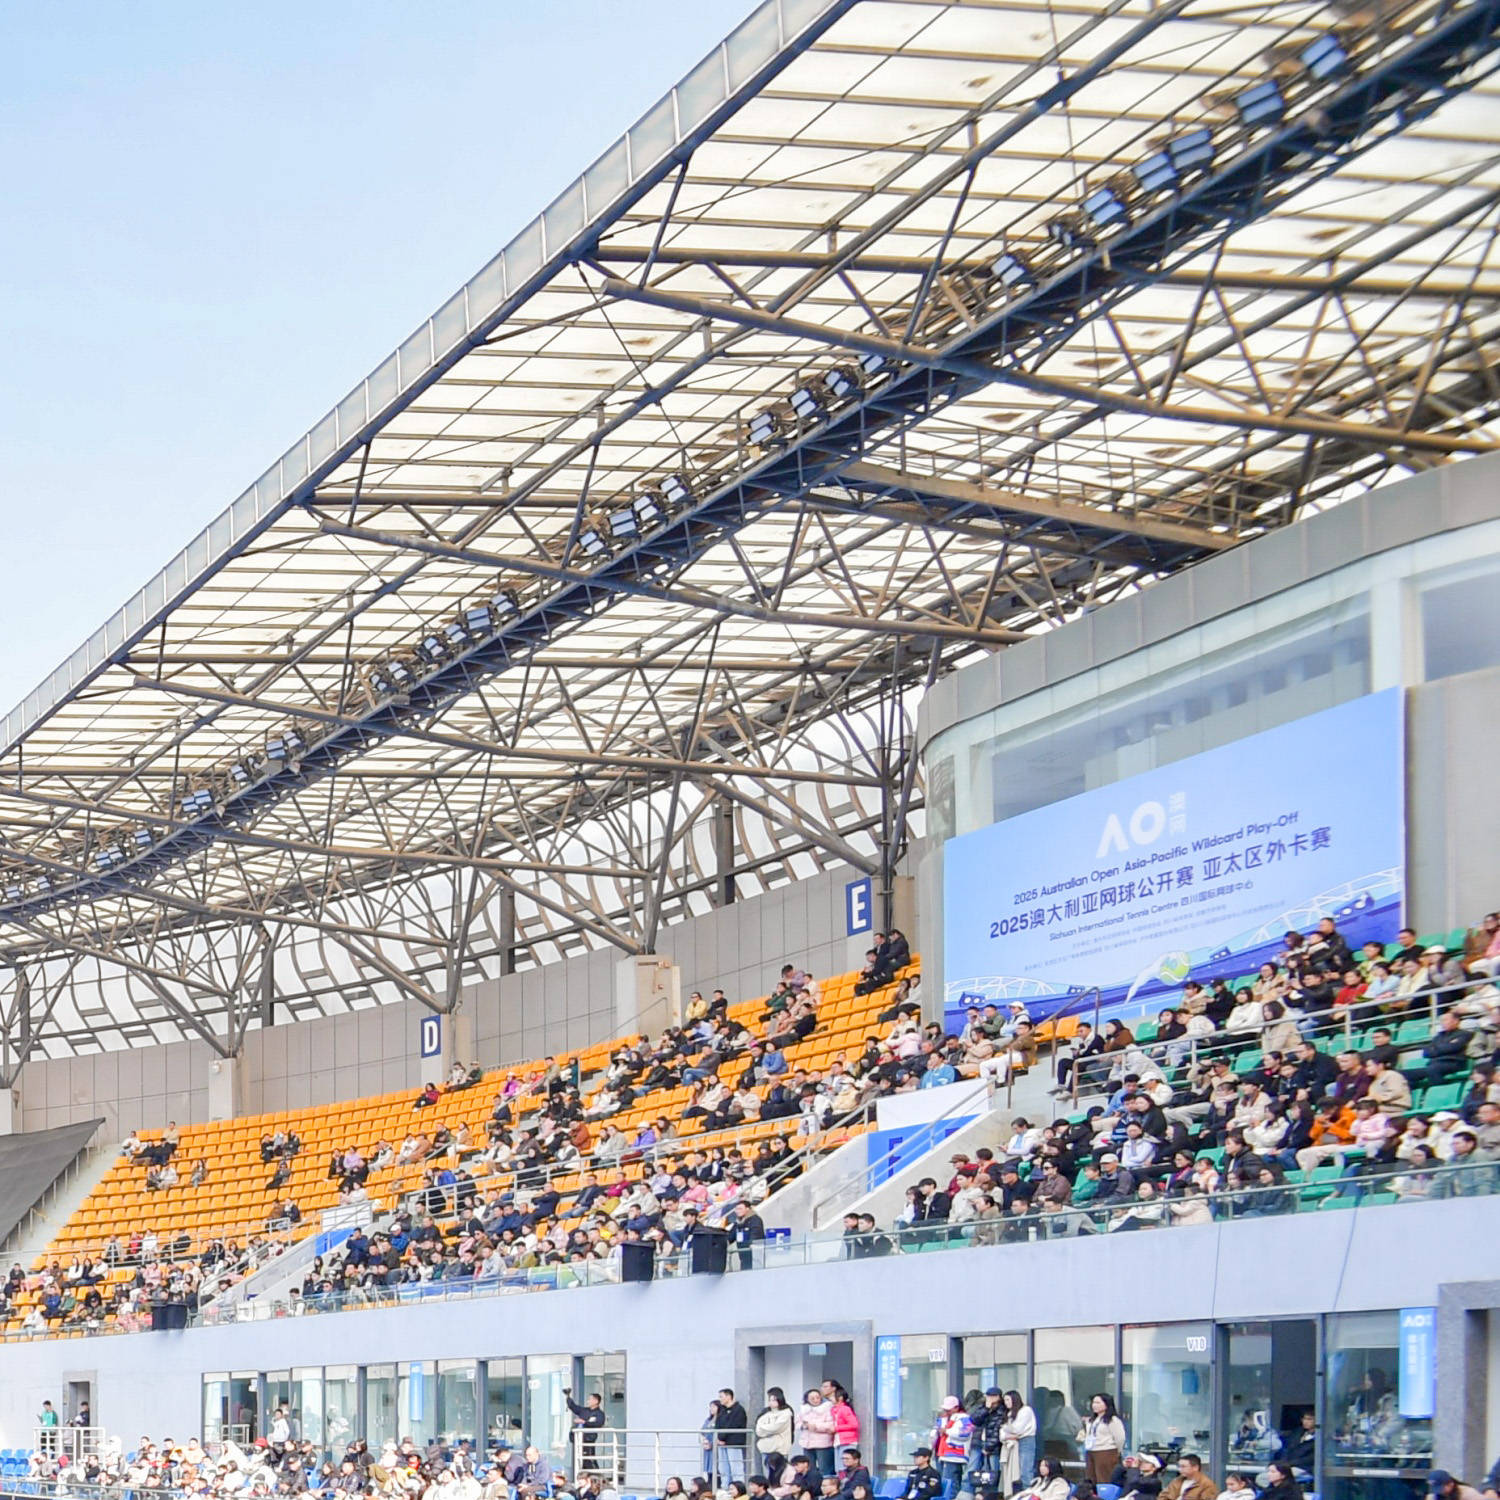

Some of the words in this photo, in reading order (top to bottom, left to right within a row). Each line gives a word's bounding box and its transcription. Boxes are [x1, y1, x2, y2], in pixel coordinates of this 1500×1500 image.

[1096, 801, 1165, 858] AO
[1014, 888, 1038, 905] 2025
[1041, 876, 1088, 897] Australian
[1091, 866, 1119, 882] Open
[1124, 846, 1188, 873] Asia-Pacific
[1191, 828, 1243, 852] Wildcard
[1246, 811, 1298, 836] Play-Off
[990, 866, 1193, 939] 2025澳大利亚网球公开赛
[1203, 826, 1331, 881] 亚太区外卡赛
[852, 884, 867, 930] E
[1078, 914, 1124, 933] International
[1126, 908, 1149, 921] Tennis
[1151, 901, 1179, 914] Centre
[424, 1020, 438, 1054] D
[1186, 1336, 1206, 1352] V10
